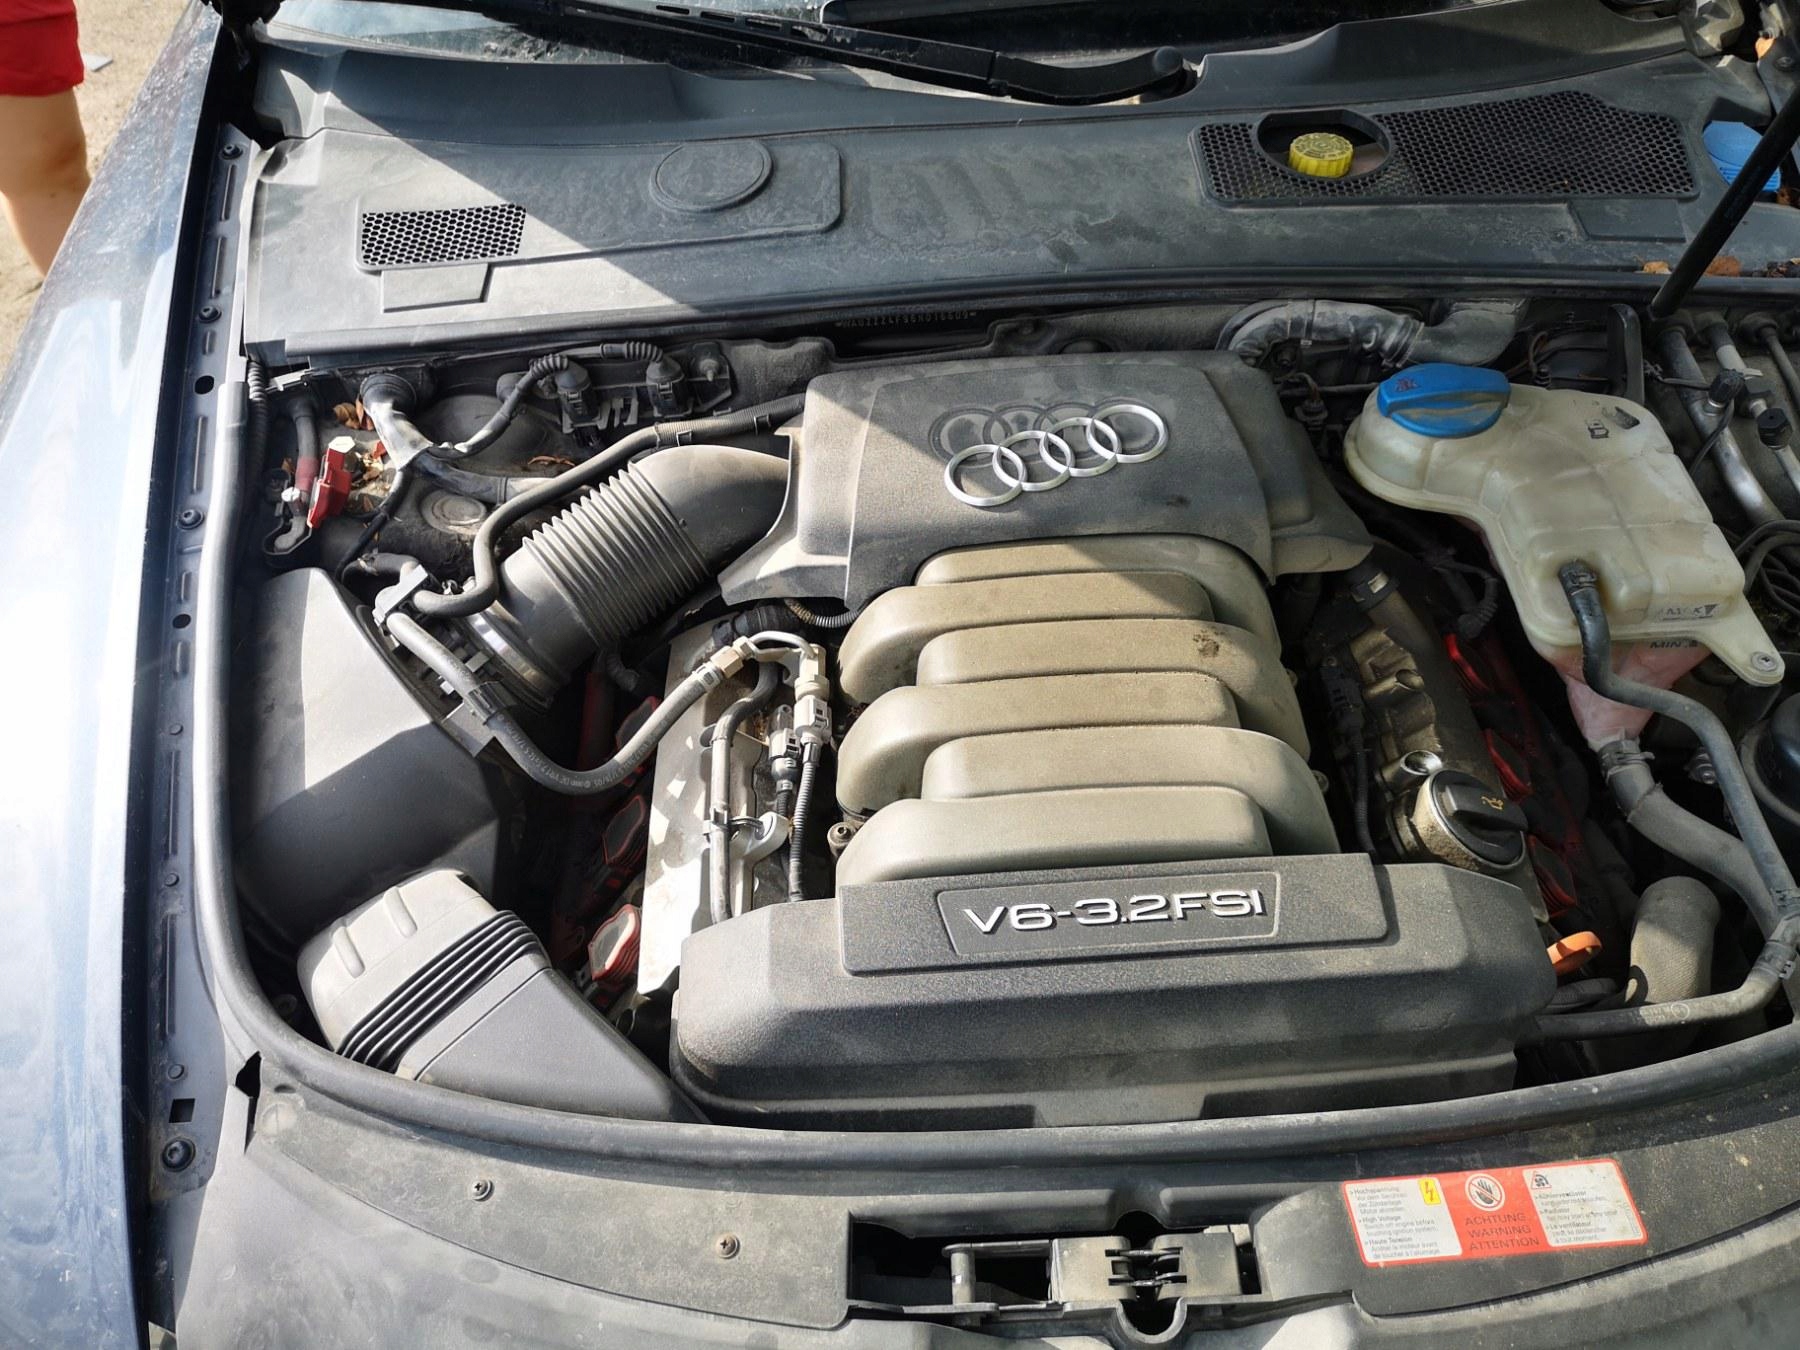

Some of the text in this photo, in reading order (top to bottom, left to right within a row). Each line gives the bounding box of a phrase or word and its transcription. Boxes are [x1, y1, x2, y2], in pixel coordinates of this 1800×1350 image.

[964, 889, 1265, 934] V6-3.2FSI
[1465, 1213, 1526, 1226] ACHTUNG
[1468, 1225, 1531, 1238] WARNING
[1470, 1236, 1540, 1251] ATTENTION
